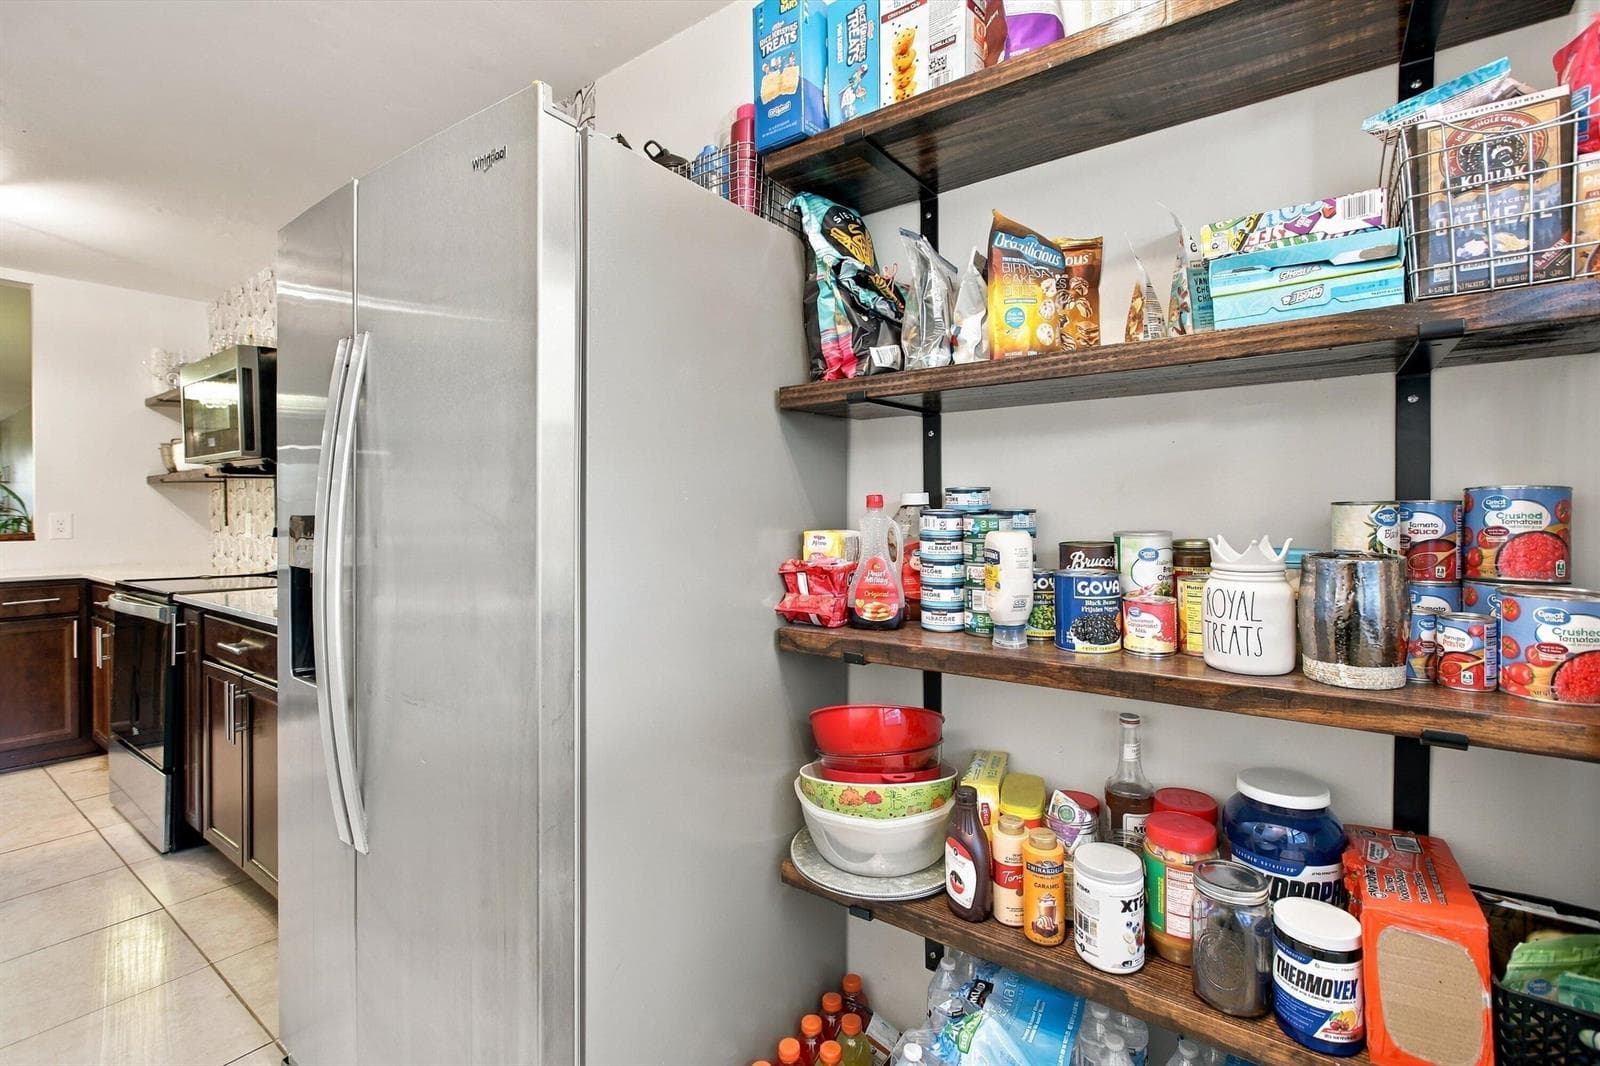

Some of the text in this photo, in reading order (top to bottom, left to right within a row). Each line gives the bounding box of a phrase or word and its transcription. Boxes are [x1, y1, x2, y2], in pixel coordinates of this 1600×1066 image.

[761, 31, 798, 58] TREATS
[847, 9, 860, 66] TREATS
[471, 144, 507, 174] Whirlpool
[1495, 511, 1543, 520] Crushed
[1407, 527, 1439, 535] Sauce
[1066, 550, 1116, 570] Bruce's
[1076, 580, 1120, 595] GOYA
[1206, 587, 1263, 623] ROYAL
[1537, 610, 1565, 619] Great
[1204, 619, 1263, 657] TREATS
[1120, 894, 1145, 914] XTE
[1276, 954, 1359, 1001] THERMOVEX
